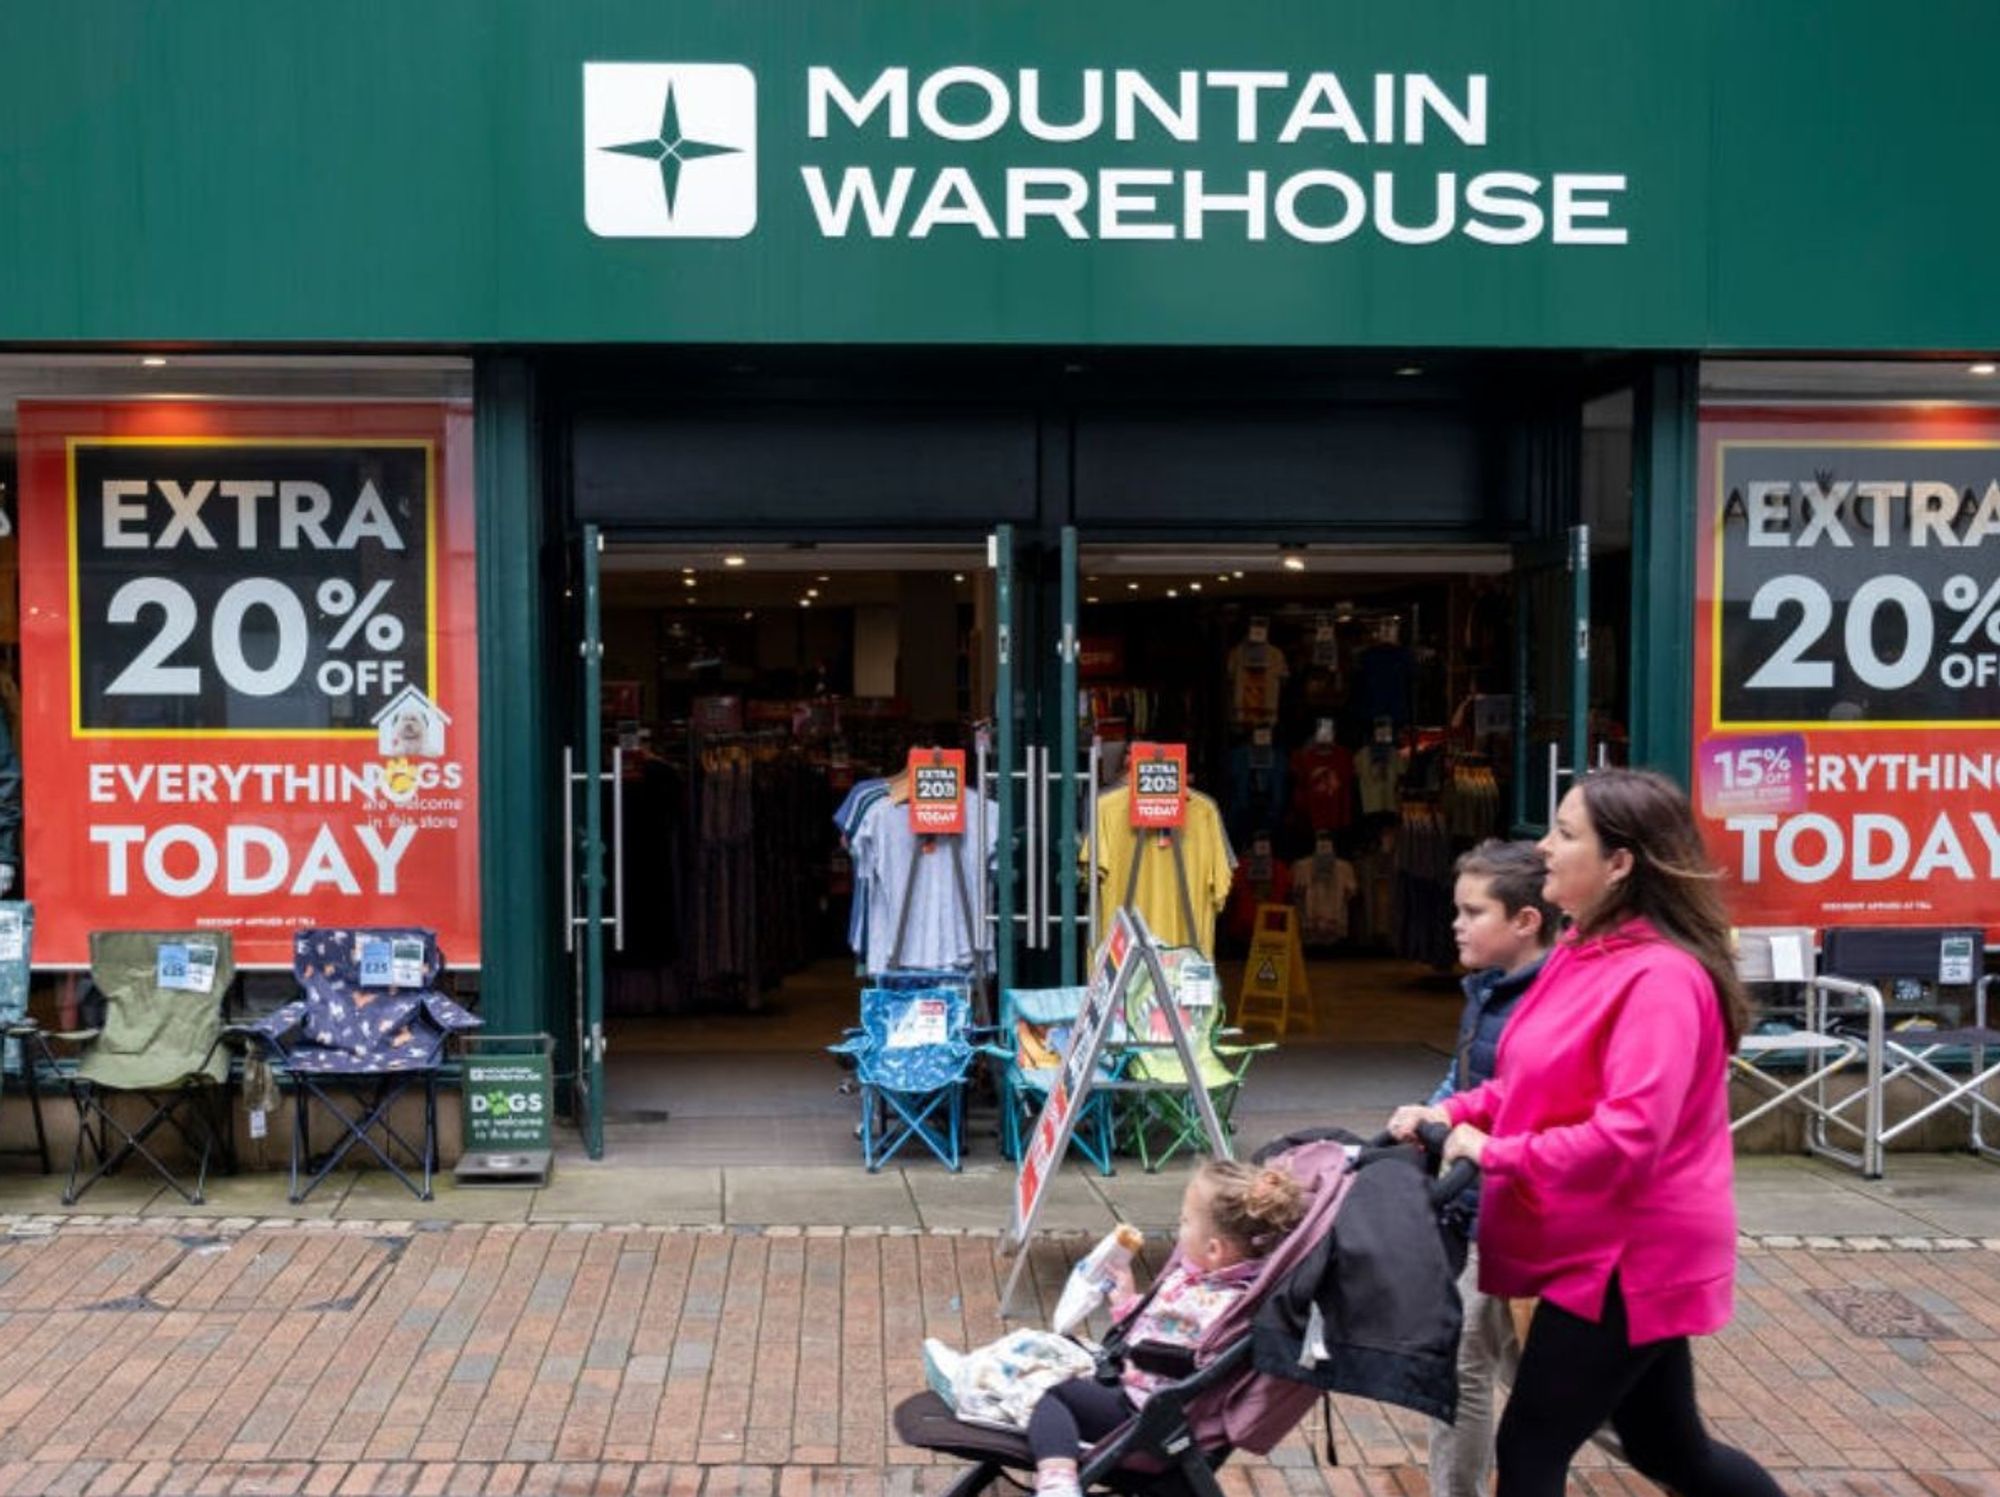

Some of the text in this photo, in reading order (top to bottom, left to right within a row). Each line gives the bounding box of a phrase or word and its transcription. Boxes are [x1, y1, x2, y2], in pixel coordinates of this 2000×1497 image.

[807, 66, 1488, 146] MOUNTAIN
[801, 166, 1629, 245] WAREHOUSE
[101, 479, 405, 550] EXTRA
[1747, 478, 2000, 547] EXTRA
[104, 576, 404, 697] 20%
[1743, 573, 2000, 690] 20%
[316, 659, 405, 696] OFF
[1940, 653, 2000, 688] OF
[1713, 746, 1792, 790] 15%
[89, 822, 418, 897] TODAY
